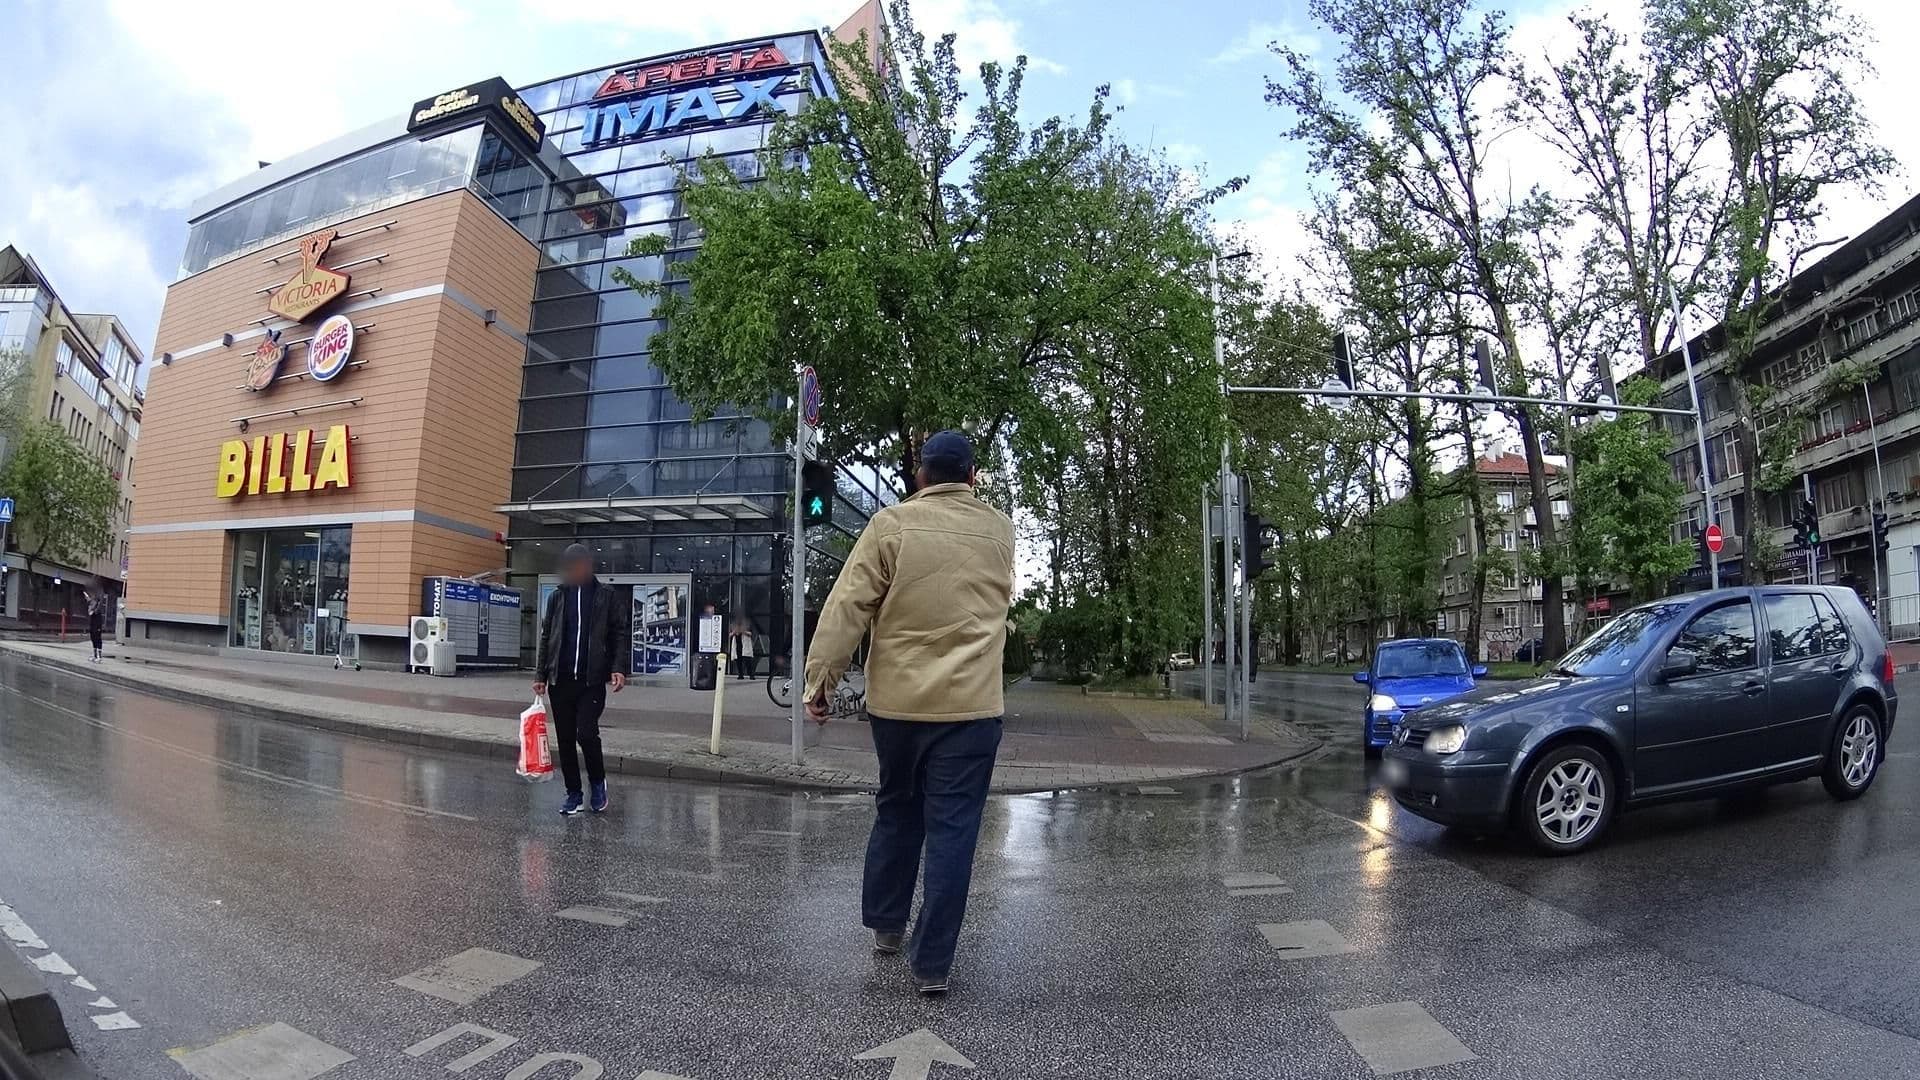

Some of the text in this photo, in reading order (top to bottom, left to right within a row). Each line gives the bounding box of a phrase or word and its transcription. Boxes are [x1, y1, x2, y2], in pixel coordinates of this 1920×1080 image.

[592, 45, 790, 98] АРЕНА
[580, 75, 788, 146] IMAX
[276, 278, 337, 307] VICTORIA
[314, 323, 348, 350] BURGER
[314, 334, 348, 366] KING
[217, 425, 353, 498] BILLA
